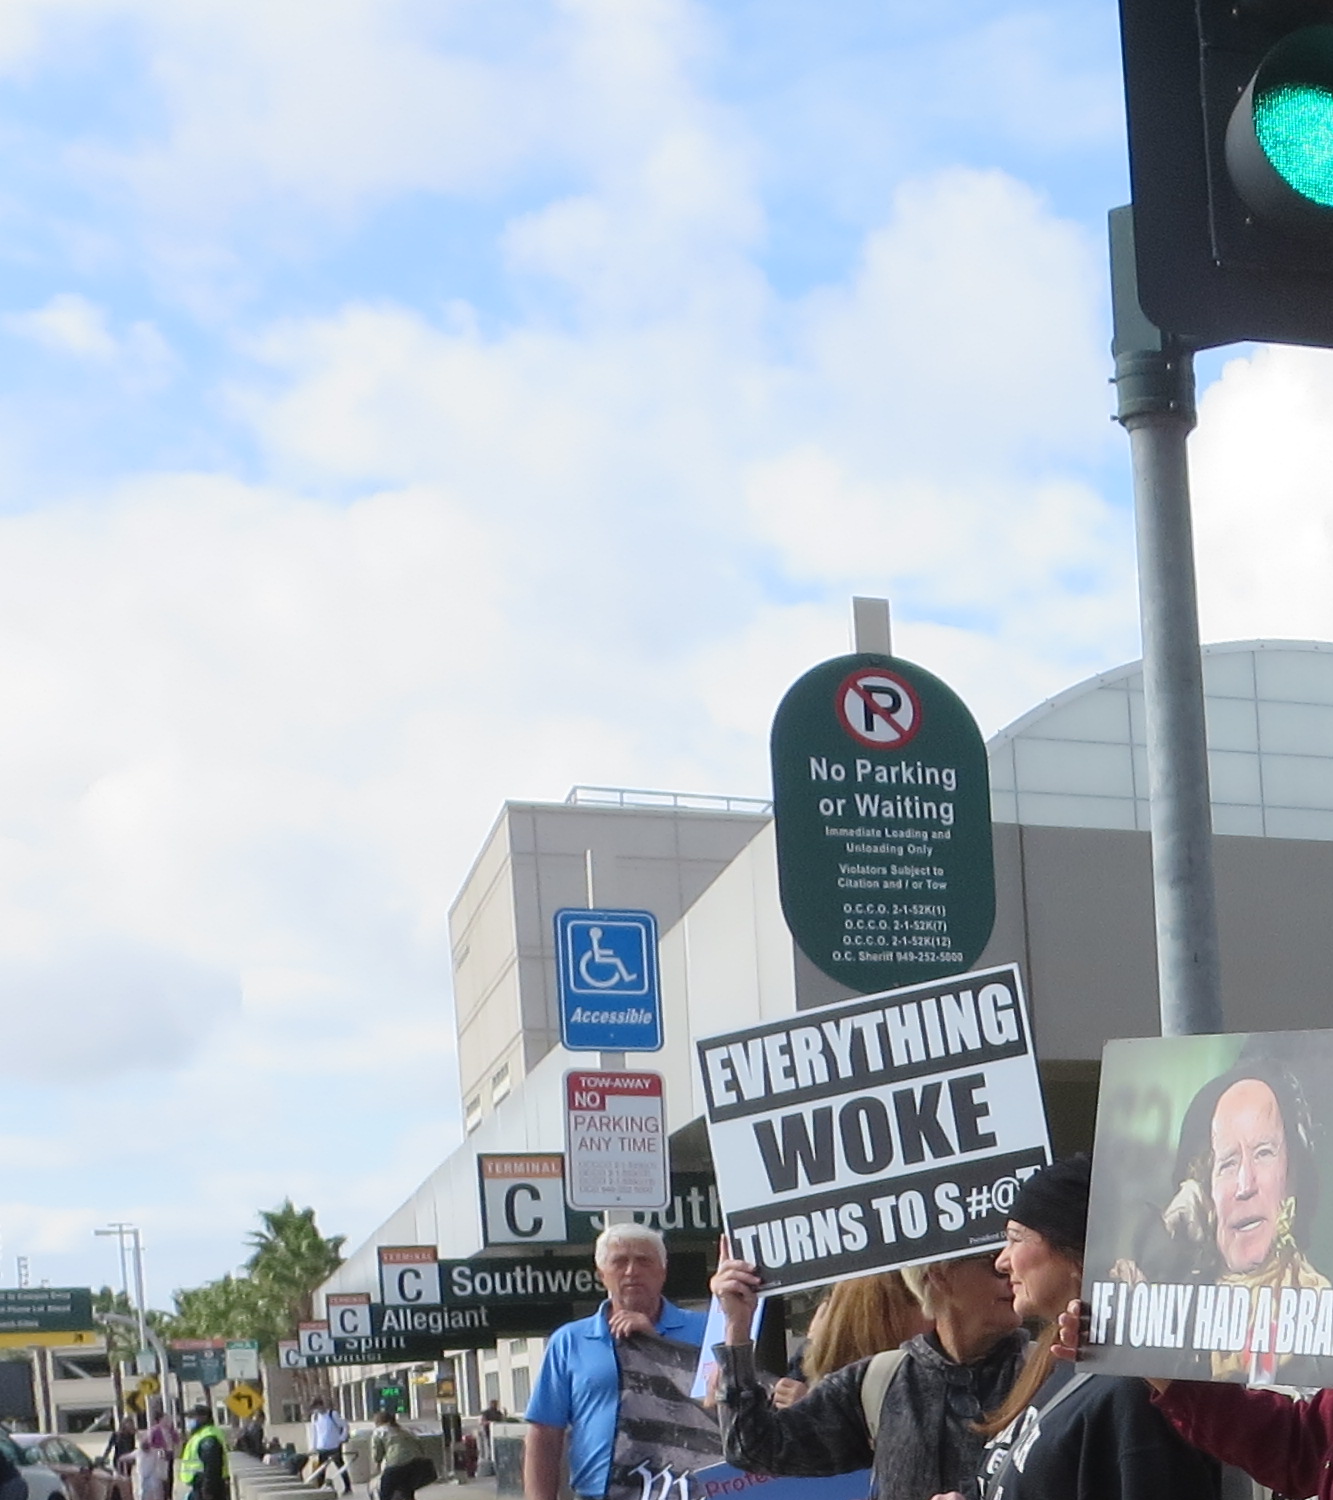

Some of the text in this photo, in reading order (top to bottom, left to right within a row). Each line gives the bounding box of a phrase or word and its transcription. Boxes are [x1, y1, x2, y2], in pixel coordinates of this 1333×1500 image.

[809, 756, 957, 791] No Parking
[818, 794, 955, 825] or Waiting
[825, 826, 951, 841] Immediate Loading and
[846, 843, 933, 857] Unloading Only
[838, 863, 944, 877] Violators Subject to
[837, 877, 880, 888] Citation
[882, 879, 902, 889] and
[913, 880, 924, 889] or
[926, 880, 948, 890] Tow
[832, 951, 856, 962] O.C.
[858, 951, 894, 962] Sheriff
[570, 1006, 652, 1025] Accessible
[704, 981, 1020, 1108] EVERYTHING
[579, 1076, 652, 1089] TOW-AWAY
[574, 1091, 600, 1108] NO
[573, 1115, 660, 1133] PARKING
[753, 1072, 998, 1194] WOKE
[578, 1137, 656, 1152] ANY TIME
[486, 1160, 560, 1174] TERMINAL
[504, 1182, 543, 1237] C
[733, 1199, 869, 1269] TURNS
[872, 1185, 929, 1245] TO
[398, 1268, 422, 1302] C
[451, 1265, 606, 1297] Southwes
[340, 1308, 359, 1334] C
[381, 1305, 490, 1333] Allegiant
[1089, 1280, 1115, 1345] IF
[1114, 1281, 1129, 1346] I
[1129, 1281, 1194, 1350] ONLY
[1192, 1284, 1252, 1352] HAD
[1250, 1285, 1277, 1355] A
[308, 1332, 324, 1352] C
[285, 1348, 300, 1367] C
